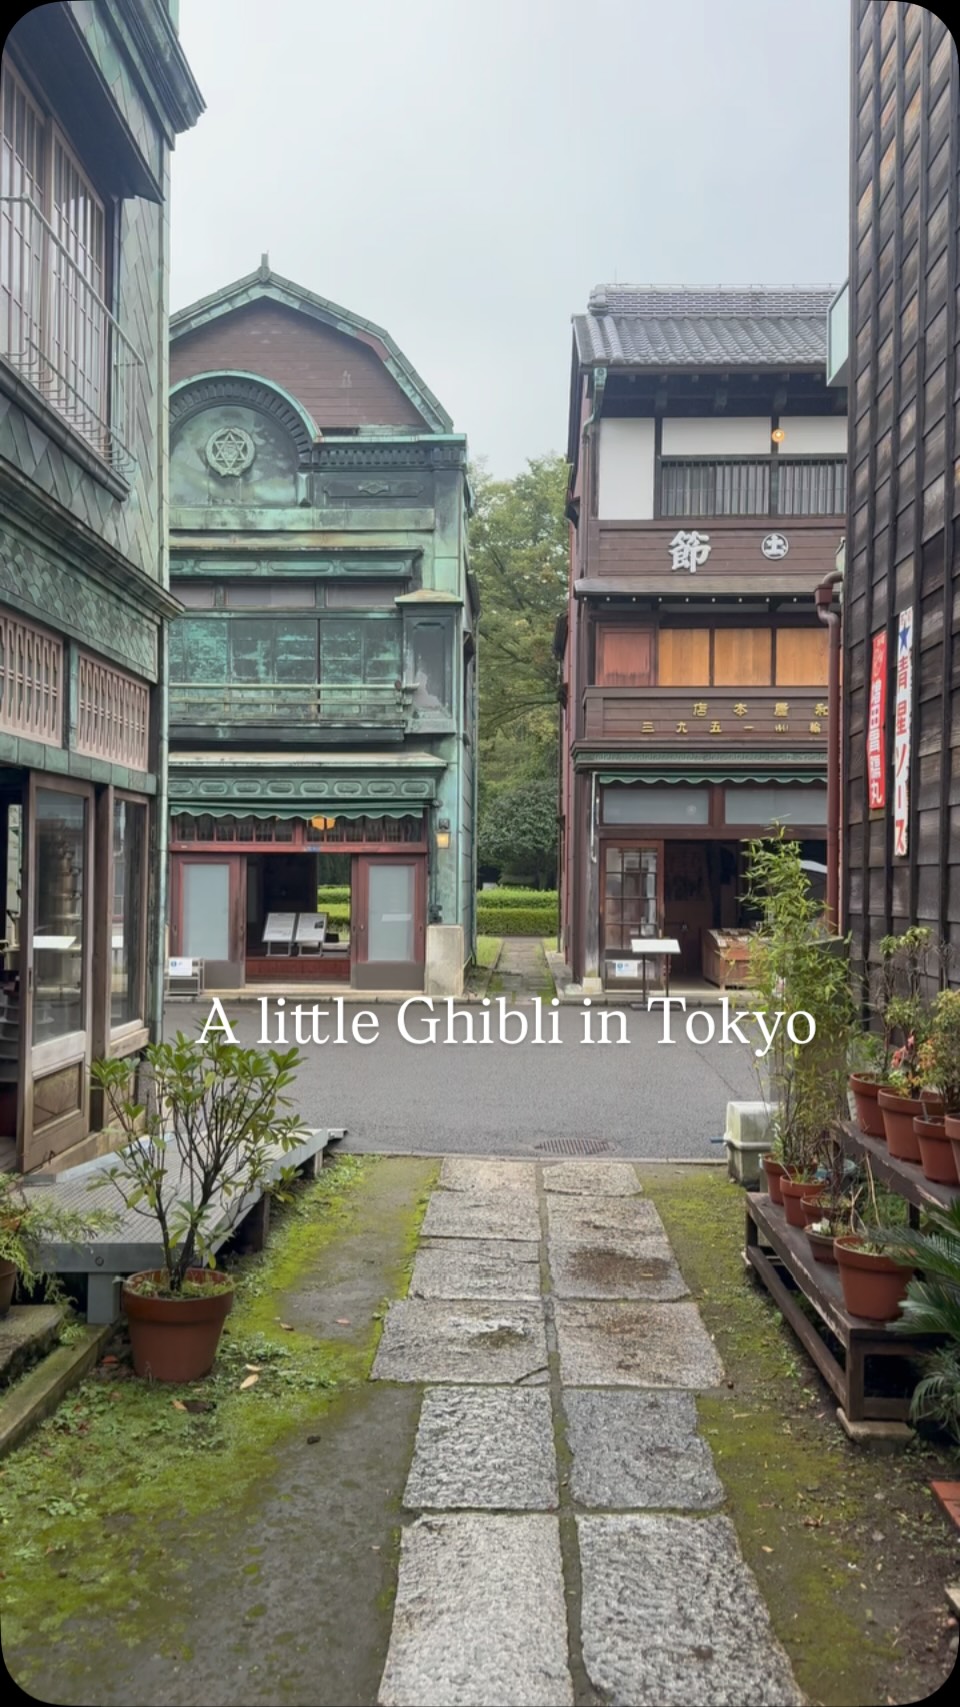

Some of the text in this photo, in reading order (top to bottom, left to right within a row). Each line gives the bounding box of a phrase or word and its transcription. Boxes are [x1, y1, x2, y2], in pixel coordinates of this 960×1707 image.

[668, 530, 712, 573] 節
[895, 655, 909, 853] 青星ソース
